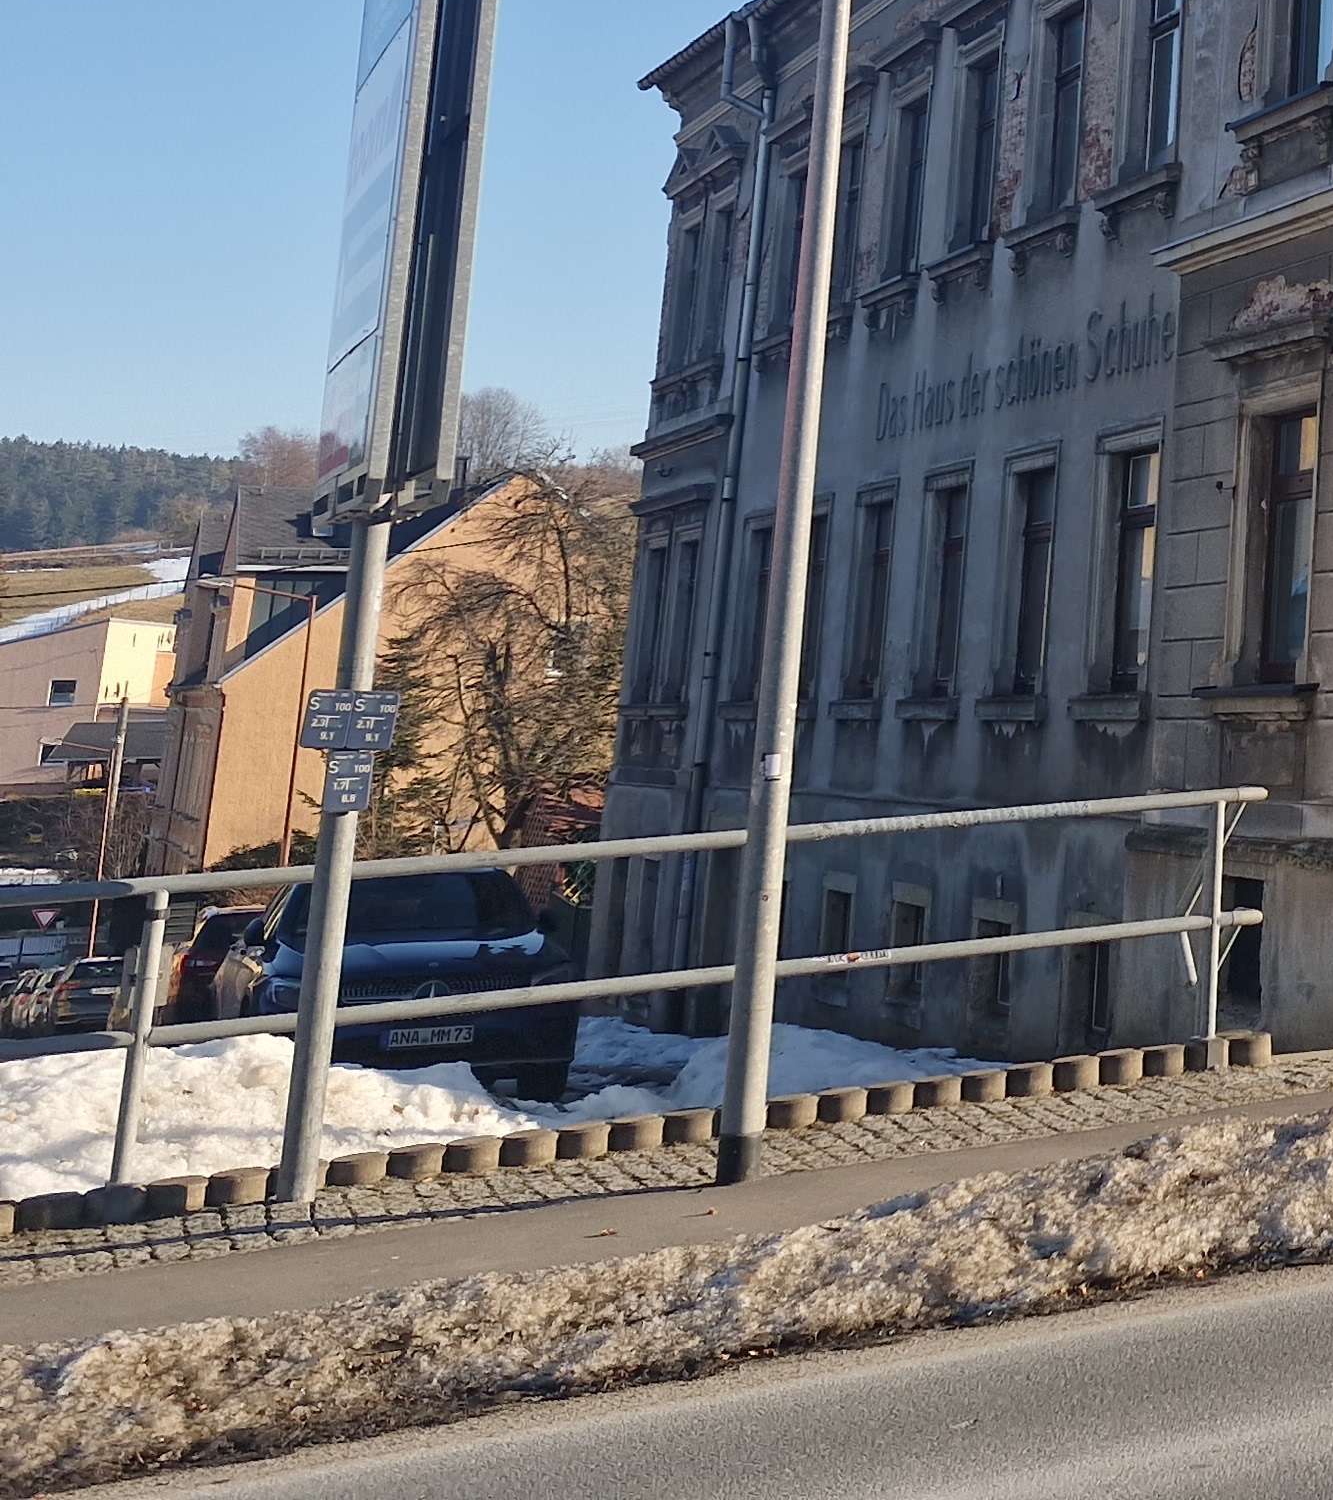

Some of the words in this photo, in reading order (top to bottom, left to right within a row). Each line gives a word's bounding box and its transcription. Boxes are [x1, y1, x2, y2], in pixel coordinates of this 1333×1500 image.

[876, 381, 907, 440] Das
[909, 363, 955, 436] Haus
[959, 353, 989, 419] der
[993, 332, 1077, 409] schönen
[1085, 294, 1177, 383] Schuhe
[309, 697, 321, 711] S
[354, 698, 366, 712] S
[328, 760, 340, 774] S
[391, 1031, 419, 1045] ANA
[431, 1029, 451, 1043] MM
[454, 1027, 473, 1041] 73
